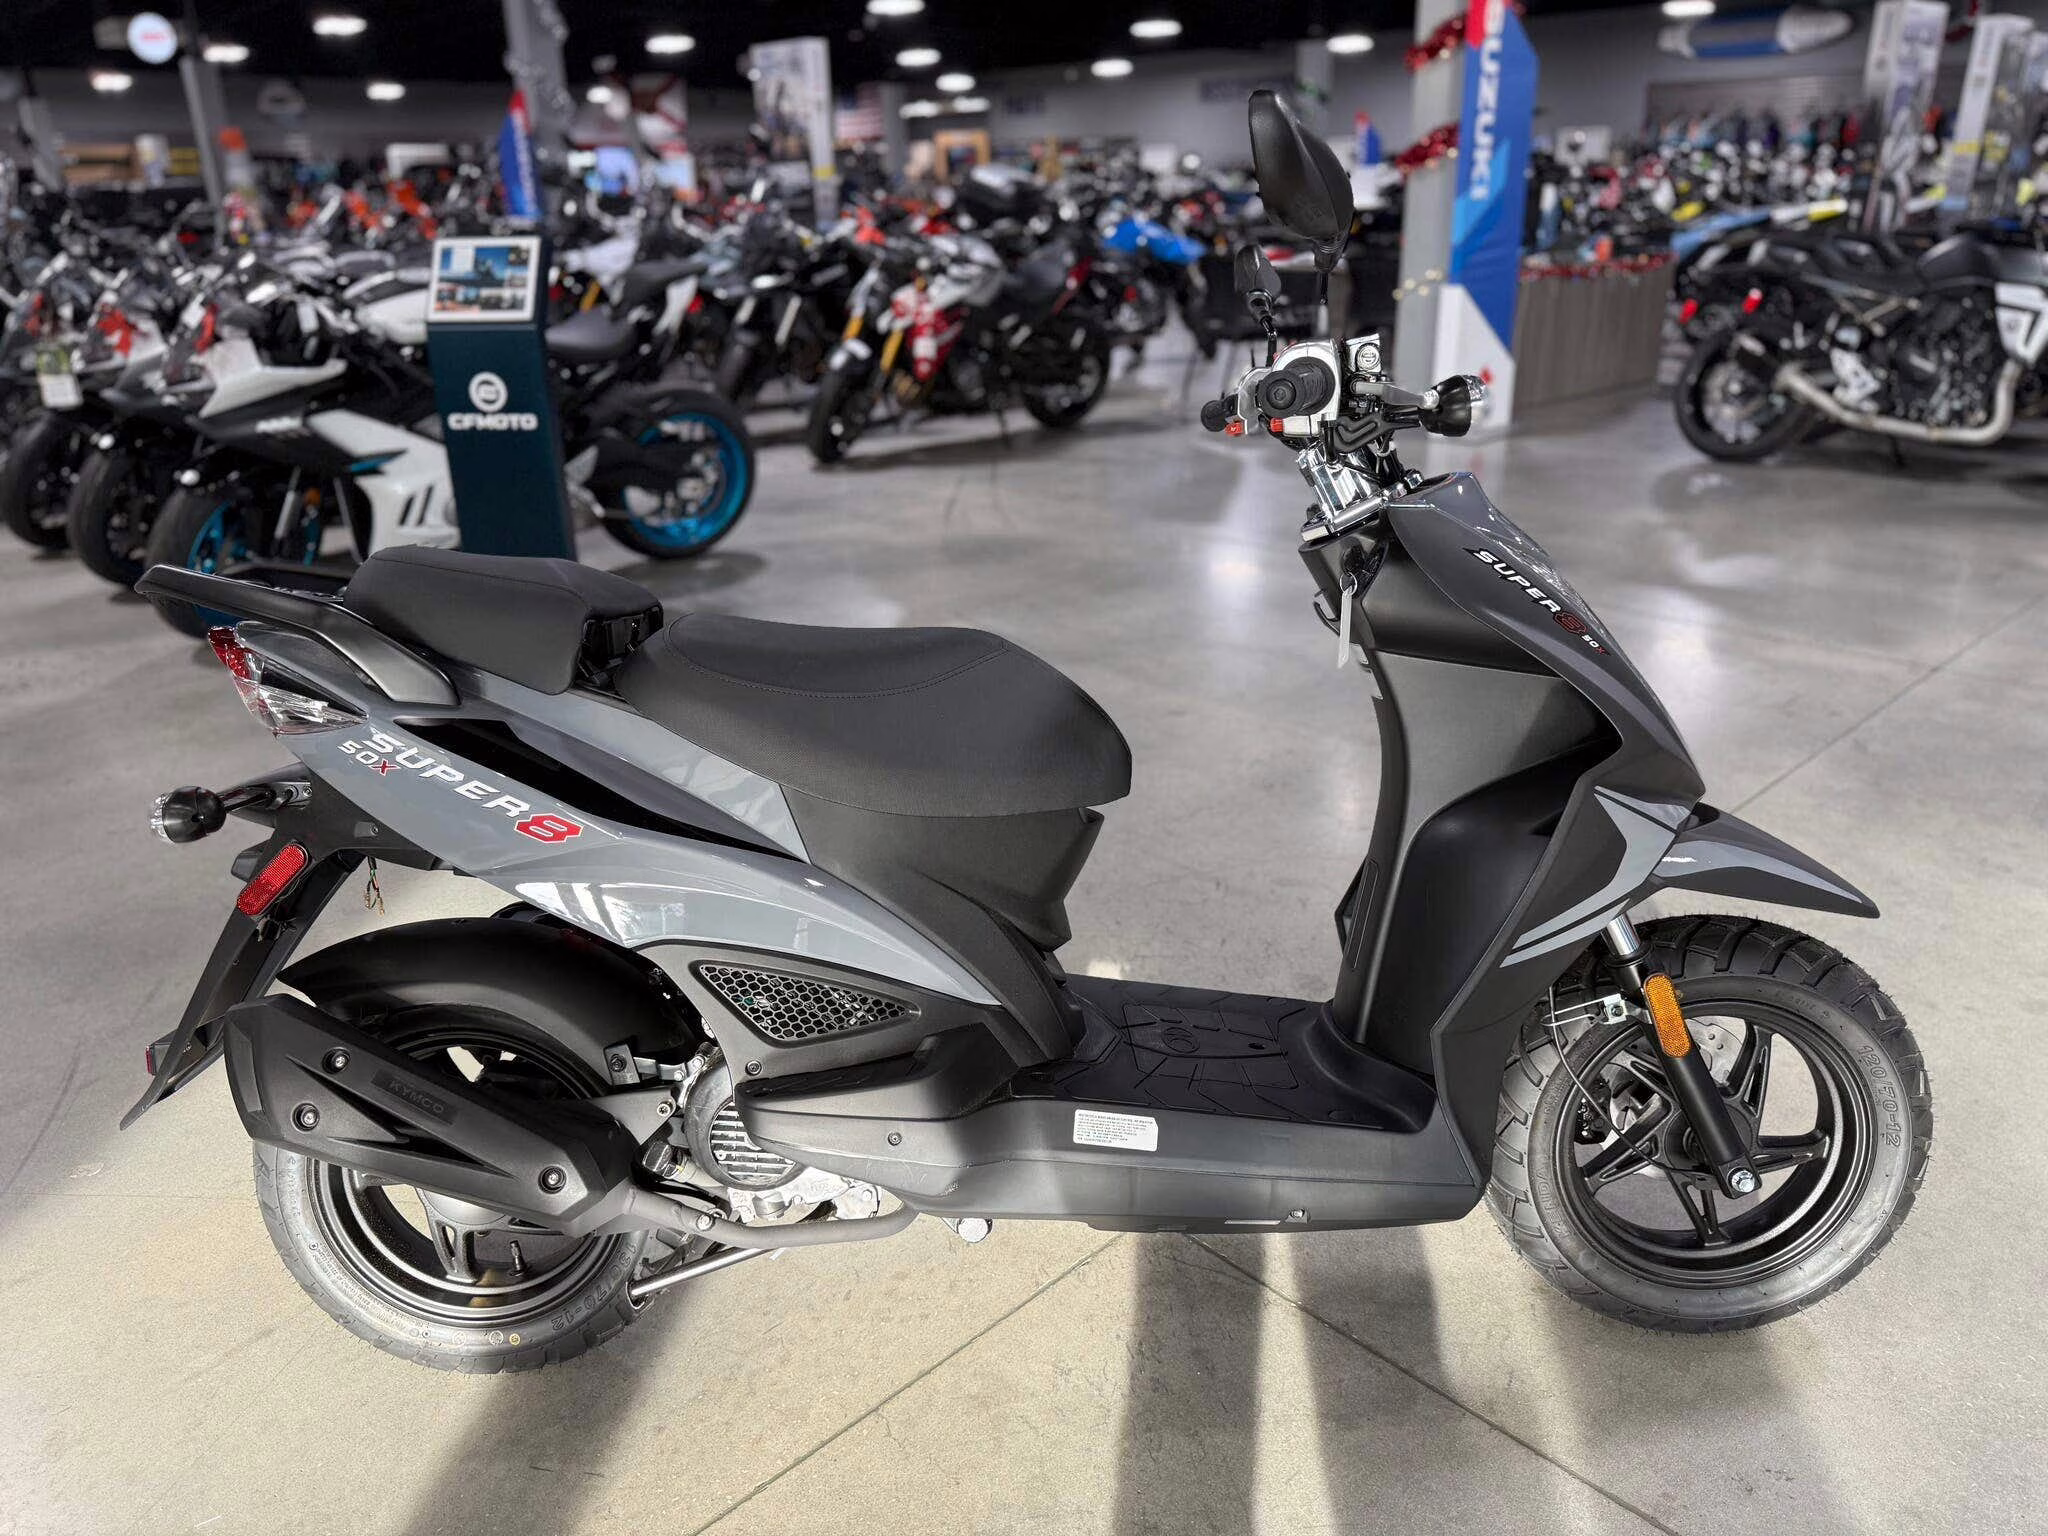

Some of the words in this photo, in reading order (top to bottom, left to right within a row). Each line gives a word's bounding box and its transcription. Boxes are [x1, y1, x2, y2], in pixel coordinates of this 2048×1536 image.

[447, 413, 538, 431] CFMOTO
[1473, 550, 1561, 613] SUPER
[337, 740, 401, 777] 50X
[361, 727, 530, 818] SUPER
[514, 813, 584, 844] 8
[389, 1080, 444, 1113] KYMCO
[1857, 1045, 1902, 1147] 120/70-12
